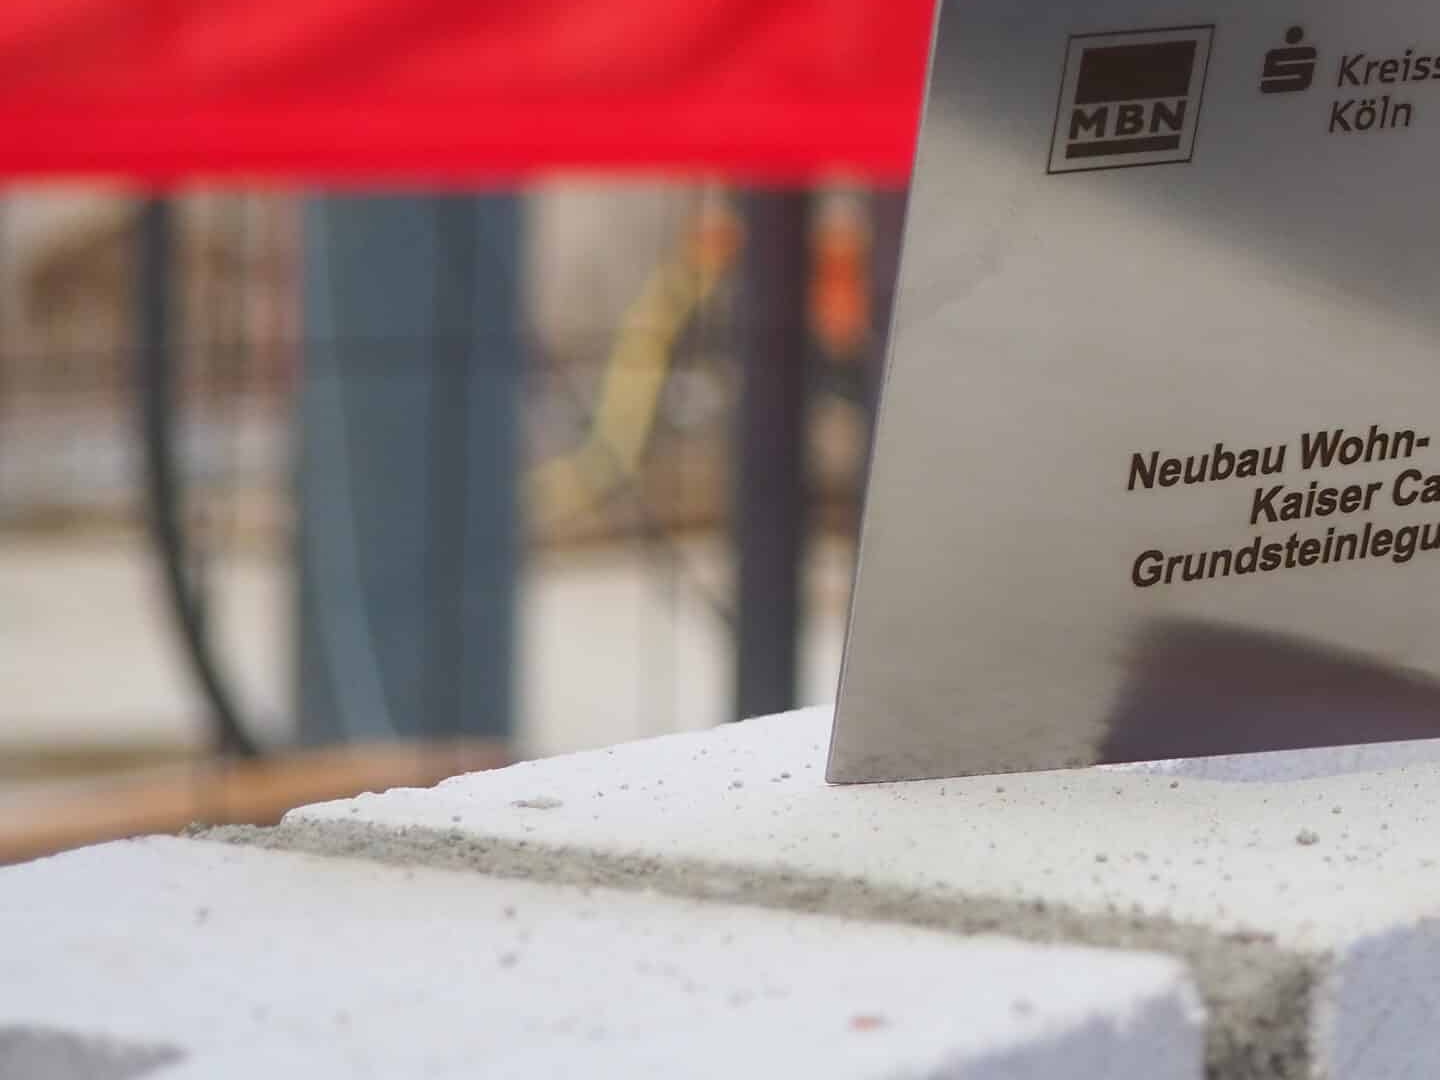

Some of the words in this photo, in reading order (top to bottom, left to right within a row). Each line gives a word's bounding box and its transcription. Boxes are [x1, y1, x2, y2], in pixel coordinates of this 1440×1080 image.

[1068, 99, 1188, 140] MBN
[1328, 95, 1413, 133] Köln
[1127, 444, 1286, 491] Neubau
[1301, 431, 1430, 471] Wohn-
[1250, 479, 1383, 526] Kaiser
